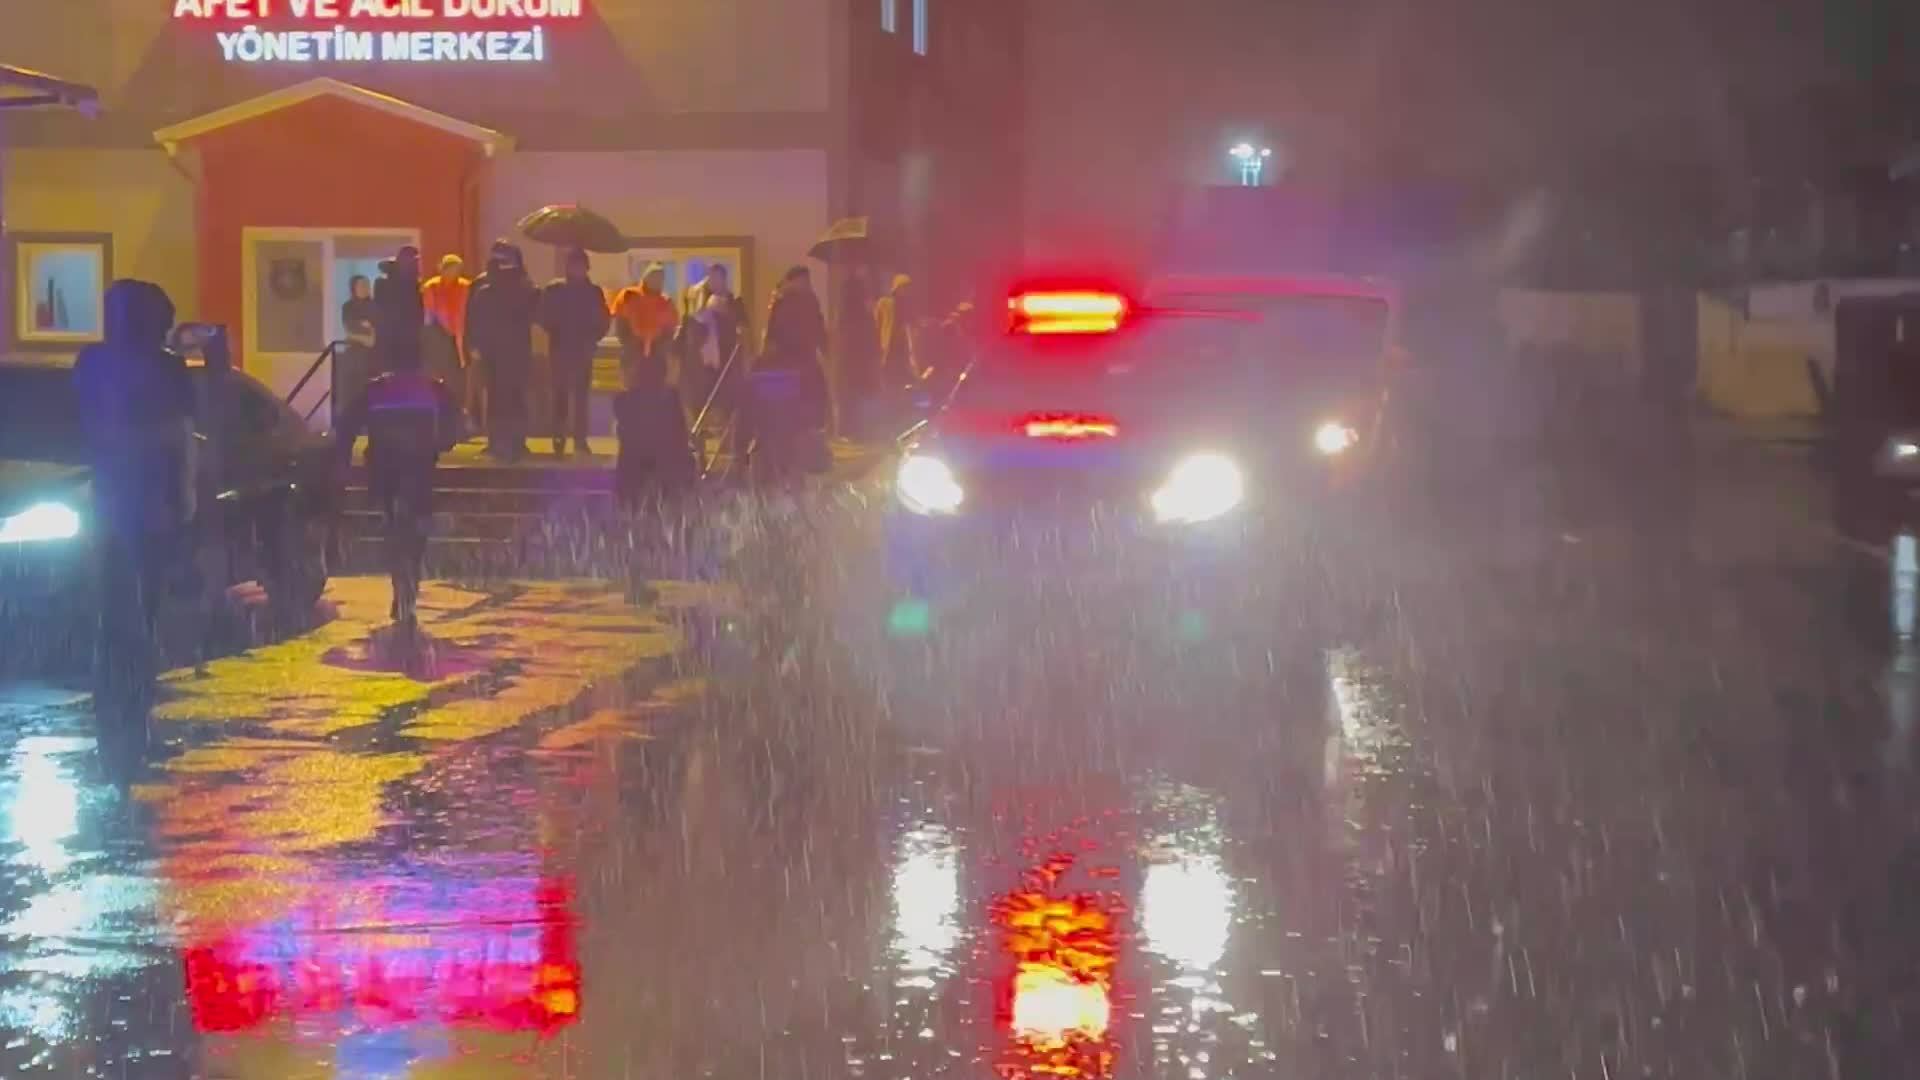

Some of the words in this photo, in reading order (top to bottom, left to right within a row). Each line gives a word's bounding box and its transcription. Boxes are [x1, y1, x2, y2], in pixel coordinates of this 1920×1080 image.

[289, 0, 339, 17] VE
[216, 25, 373, 60] YÖNETİM
[381, 25, 543, 60] MERKEZİ
